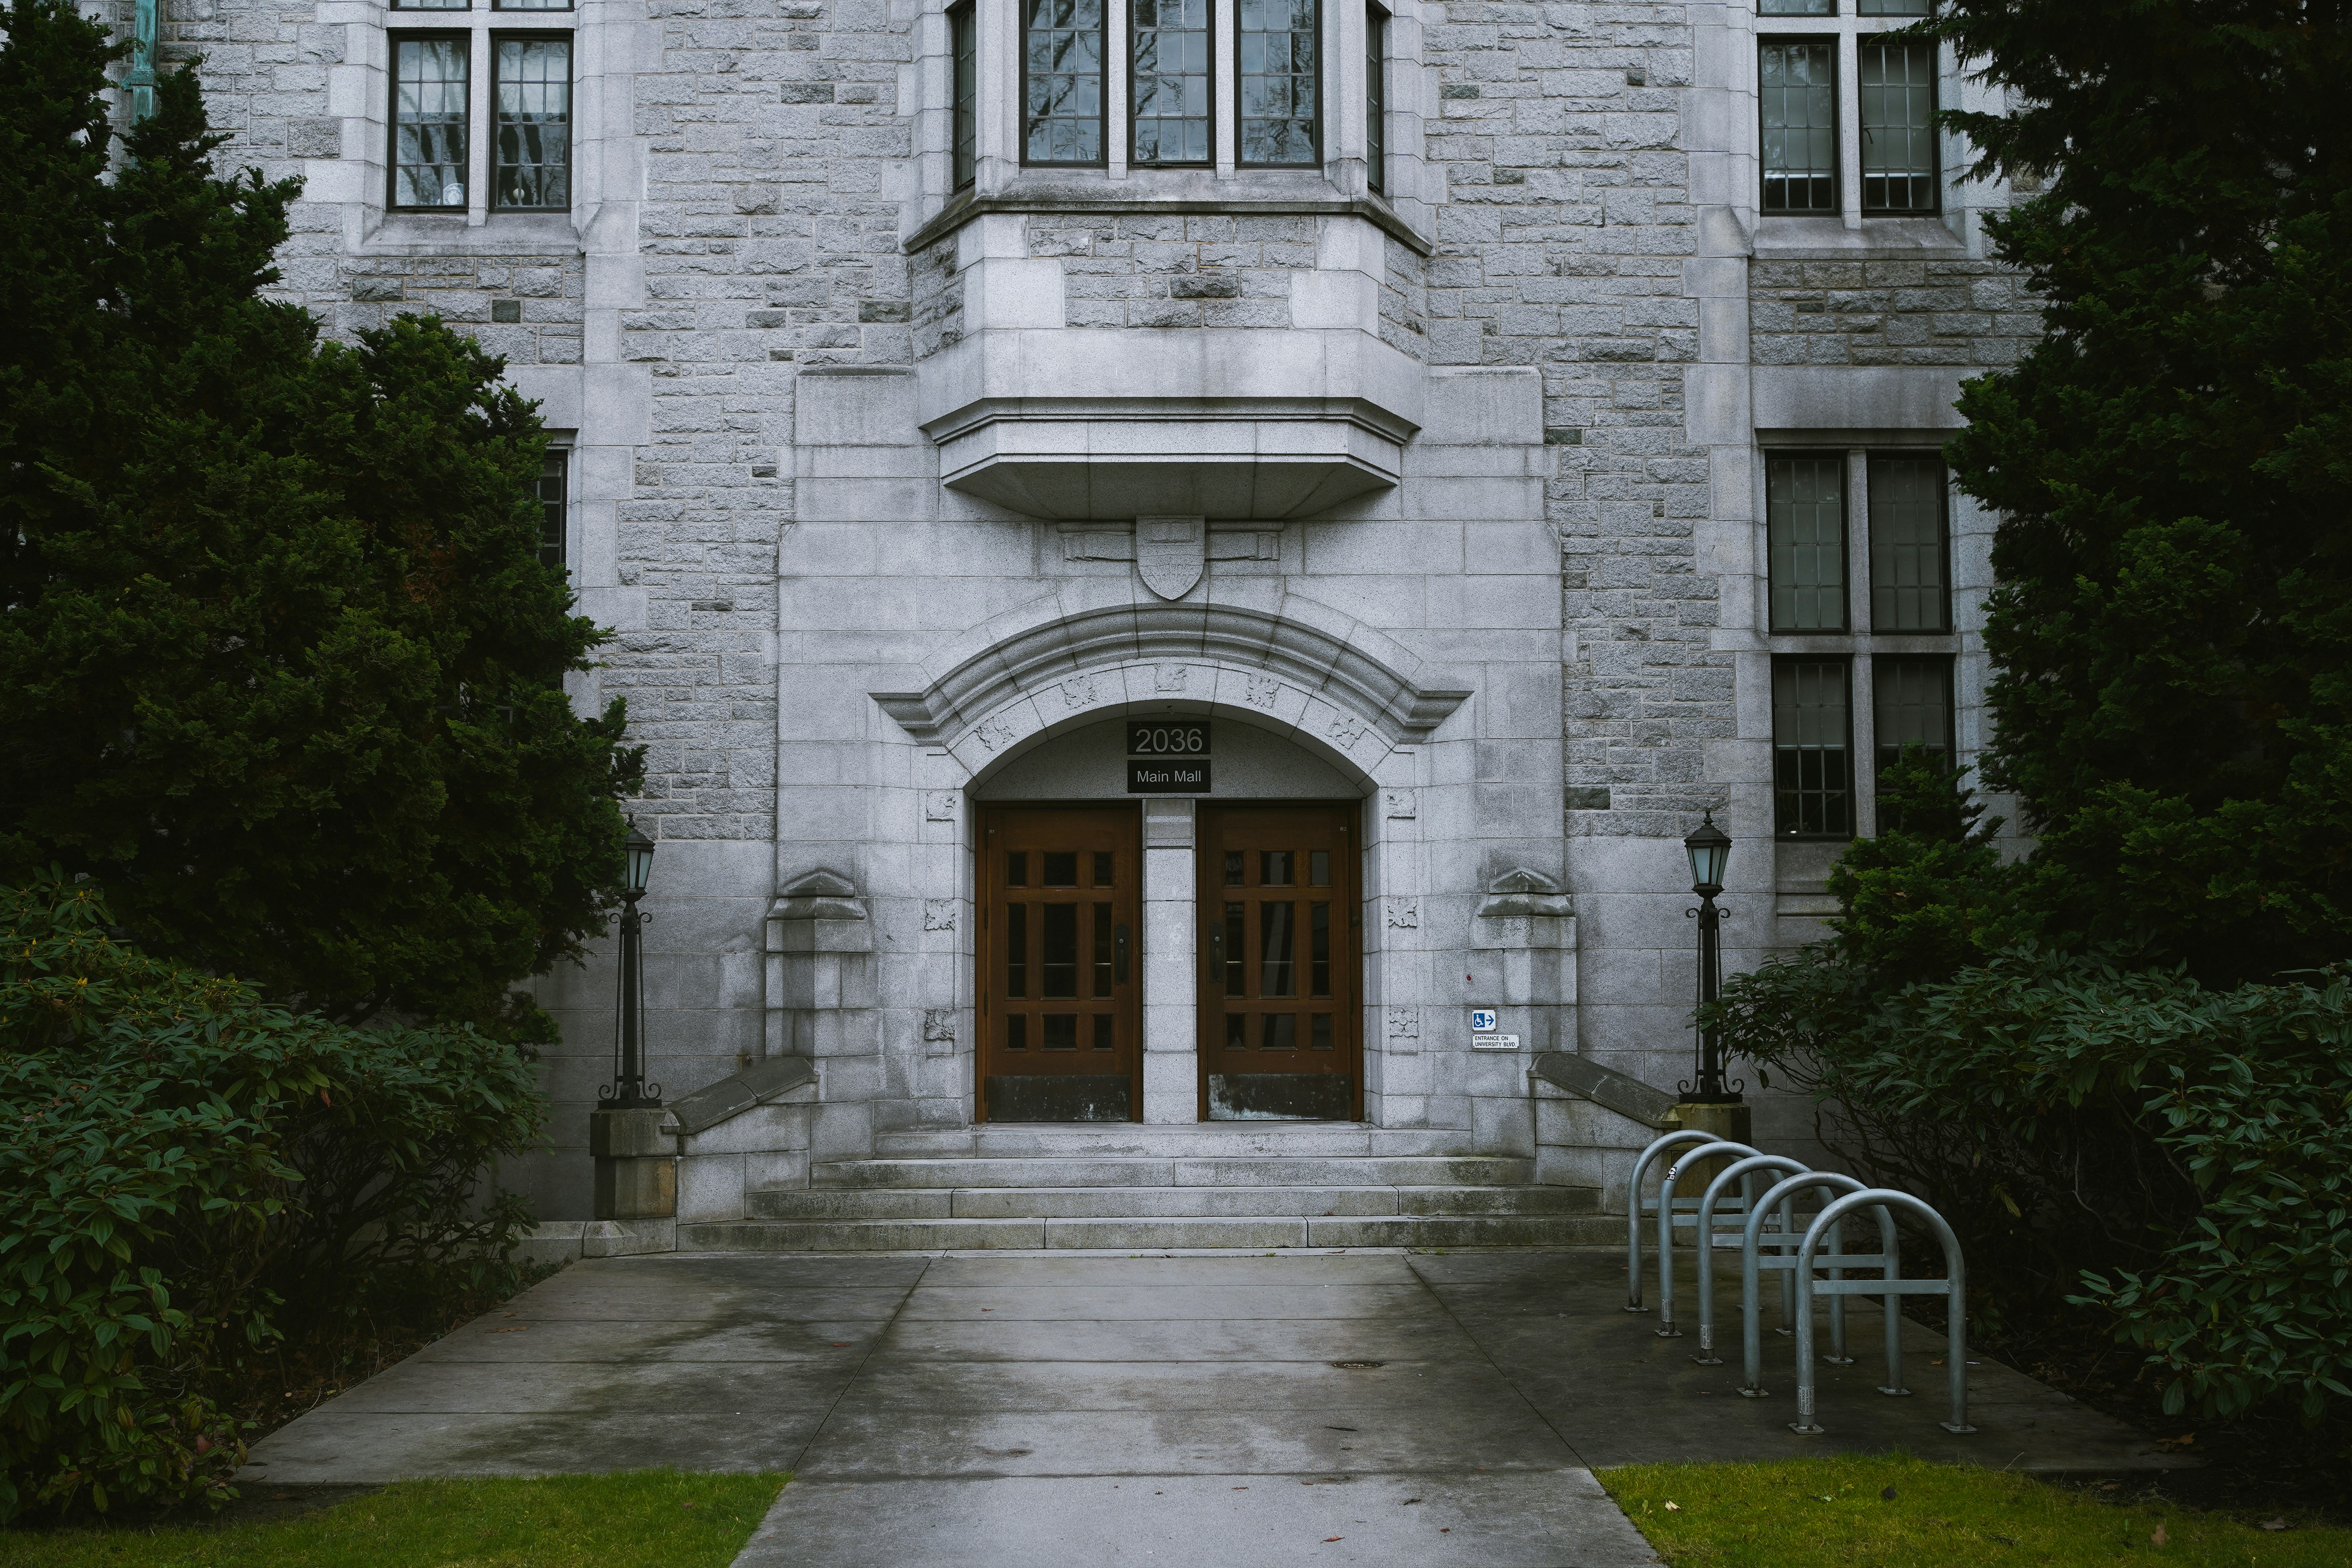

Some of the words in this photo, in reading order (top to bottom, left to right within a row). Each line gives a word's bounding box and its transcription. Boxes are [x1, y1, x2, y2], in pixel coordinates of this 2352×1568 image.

[1136, 728, 1202, 752] 2036
[1137, 771, 1169, 782] Main
[1174, 770, 1201, 782] Mall
